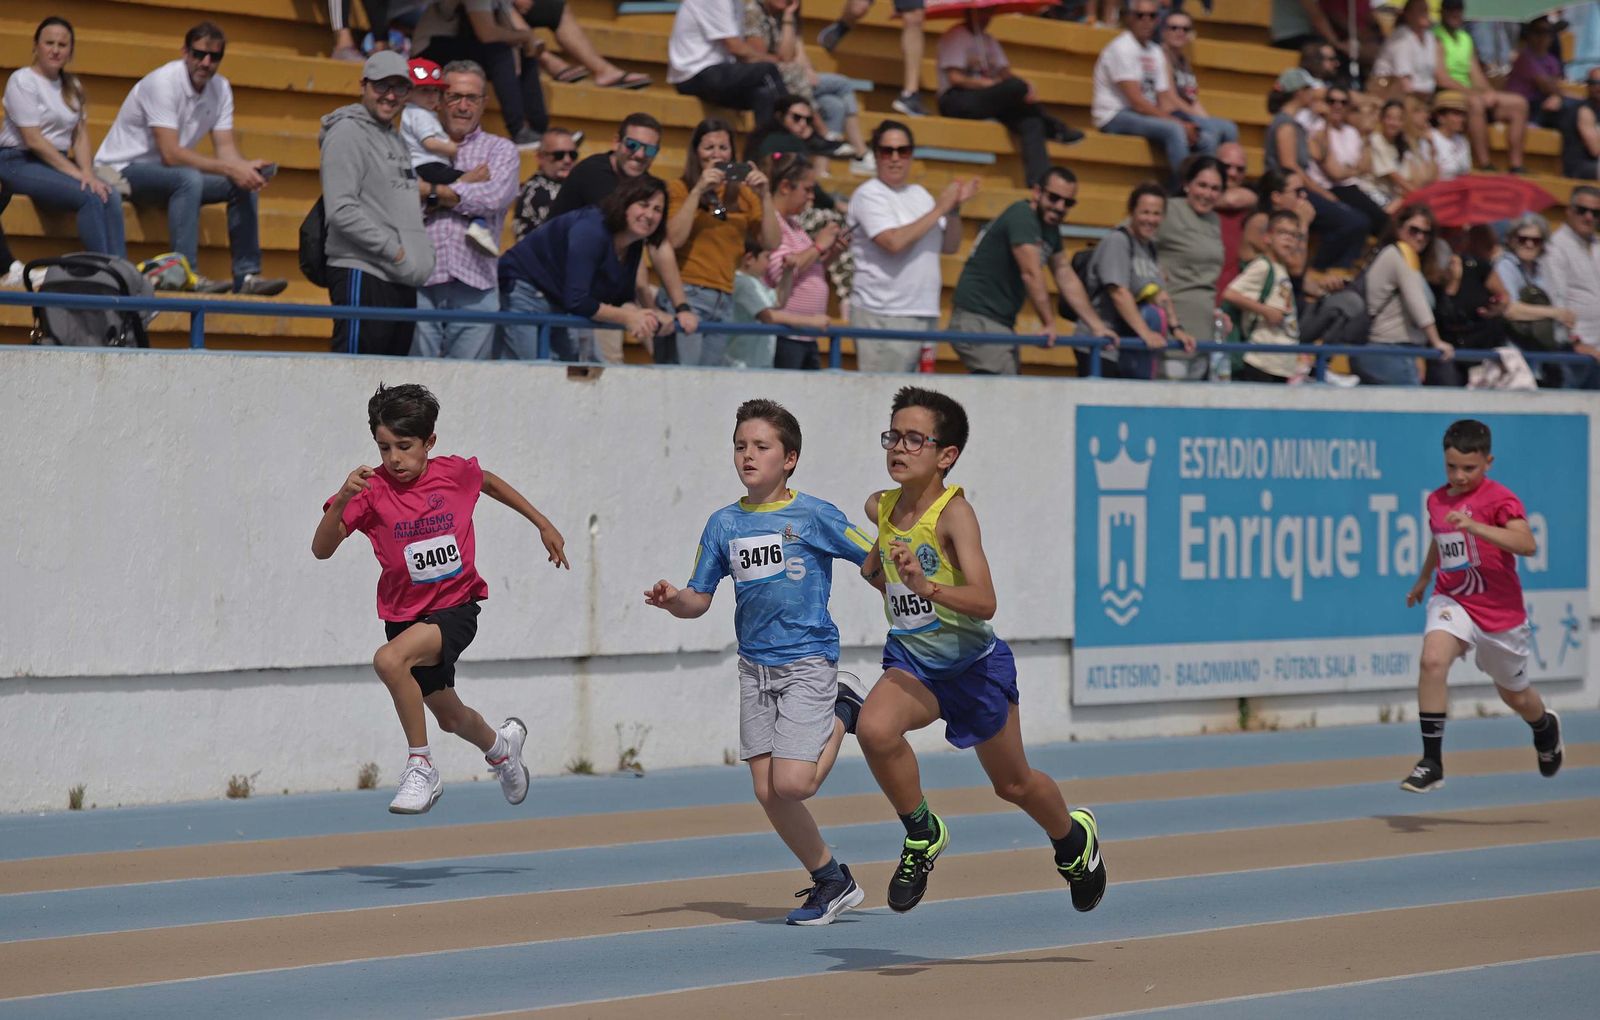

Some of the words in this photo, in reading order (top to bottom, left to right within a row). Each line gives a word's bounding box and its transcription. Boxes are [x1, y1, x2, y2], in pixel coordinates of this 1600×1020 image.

[1179, 437, 1269, 479] ESTADIO
[1272, 438, 1382, 480] MUNICIPAL
[394, 513, 454, 531] ATLETISMO
[394, 522, 455, 539] INMACULADA
[413, 544, 459, 571] 3409
[739, 544, 783, 569] 3476
[1179, 489, 1362, 601] Enrique
[891, 593, 933, 617] 3455
[1087, 663, 1160, 689] ATLETISMO
[1176, 658, 1261, 686] BALONMANO
[1274, 653, 1322, 680] FÚTBOL
[1325, 653, 1356, 677] SALA
[1371, 652, 1411, 675] RUGBY
